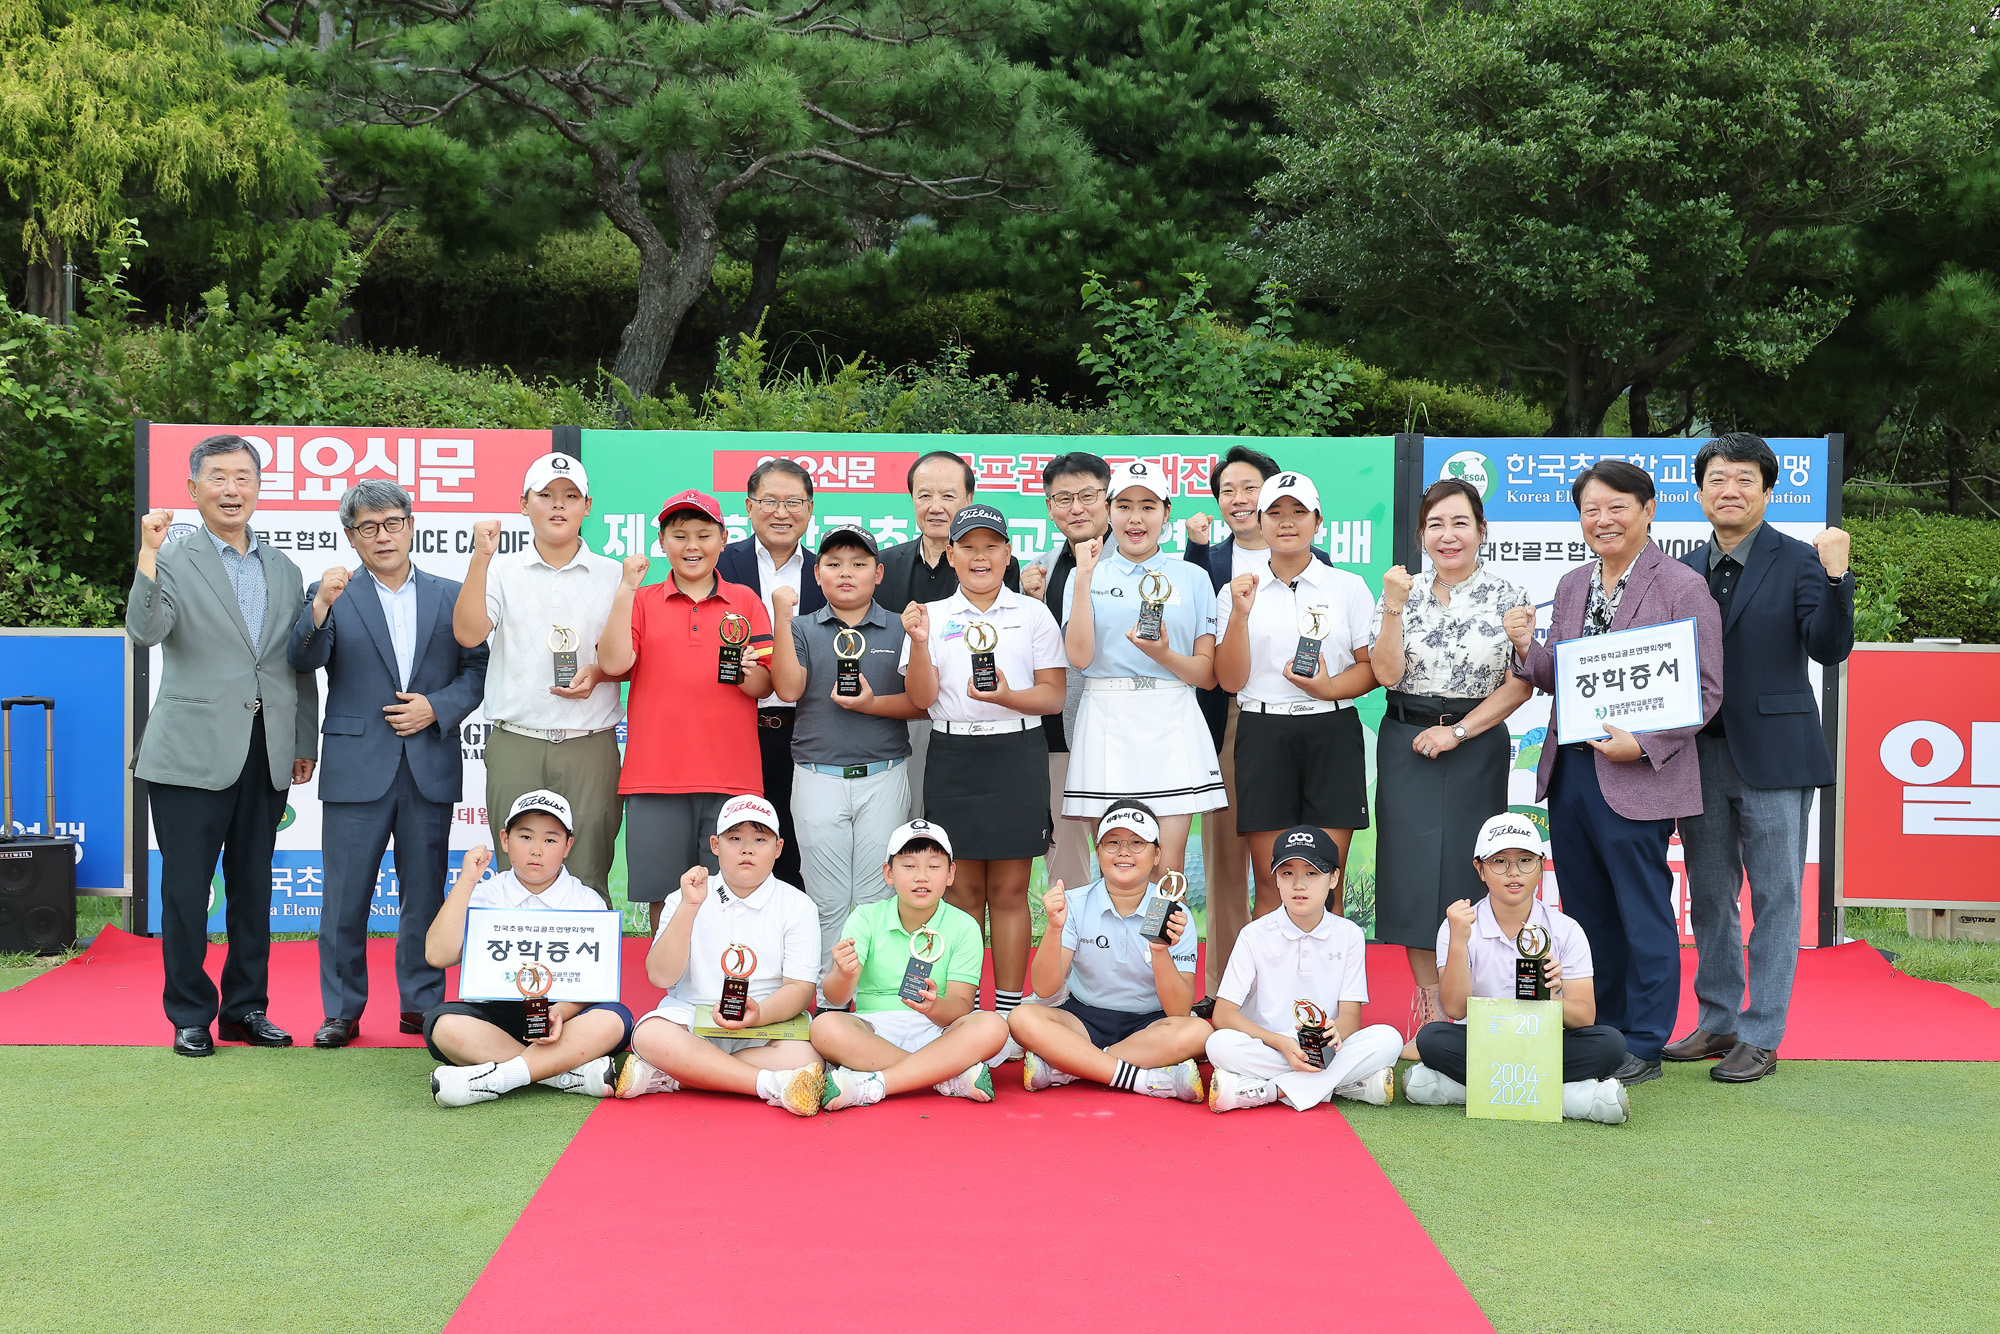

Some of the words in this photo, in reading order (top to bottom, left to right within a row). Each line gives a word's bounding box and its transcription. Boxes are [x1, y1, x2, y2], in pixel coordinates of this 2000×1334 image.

[1507, 490, 1551, 503] Korea
[1655, 490, 1690, 503] chool
[956, 507, 1003, 525] Titleist
[1575, 657, 1680, 699] 장학증서
[517, 794, 567, 814] Titleist
[722, 799, 774, 819] Titleist
[1487, 824, 1532, 842] Titleist
[716, 884, 730, 904] WAAC
[486, 939, 600, 963] 장학증서
[1514, 1013, 1540, 1035] 20
[1489, 1083, 1540, 1106] 2024
